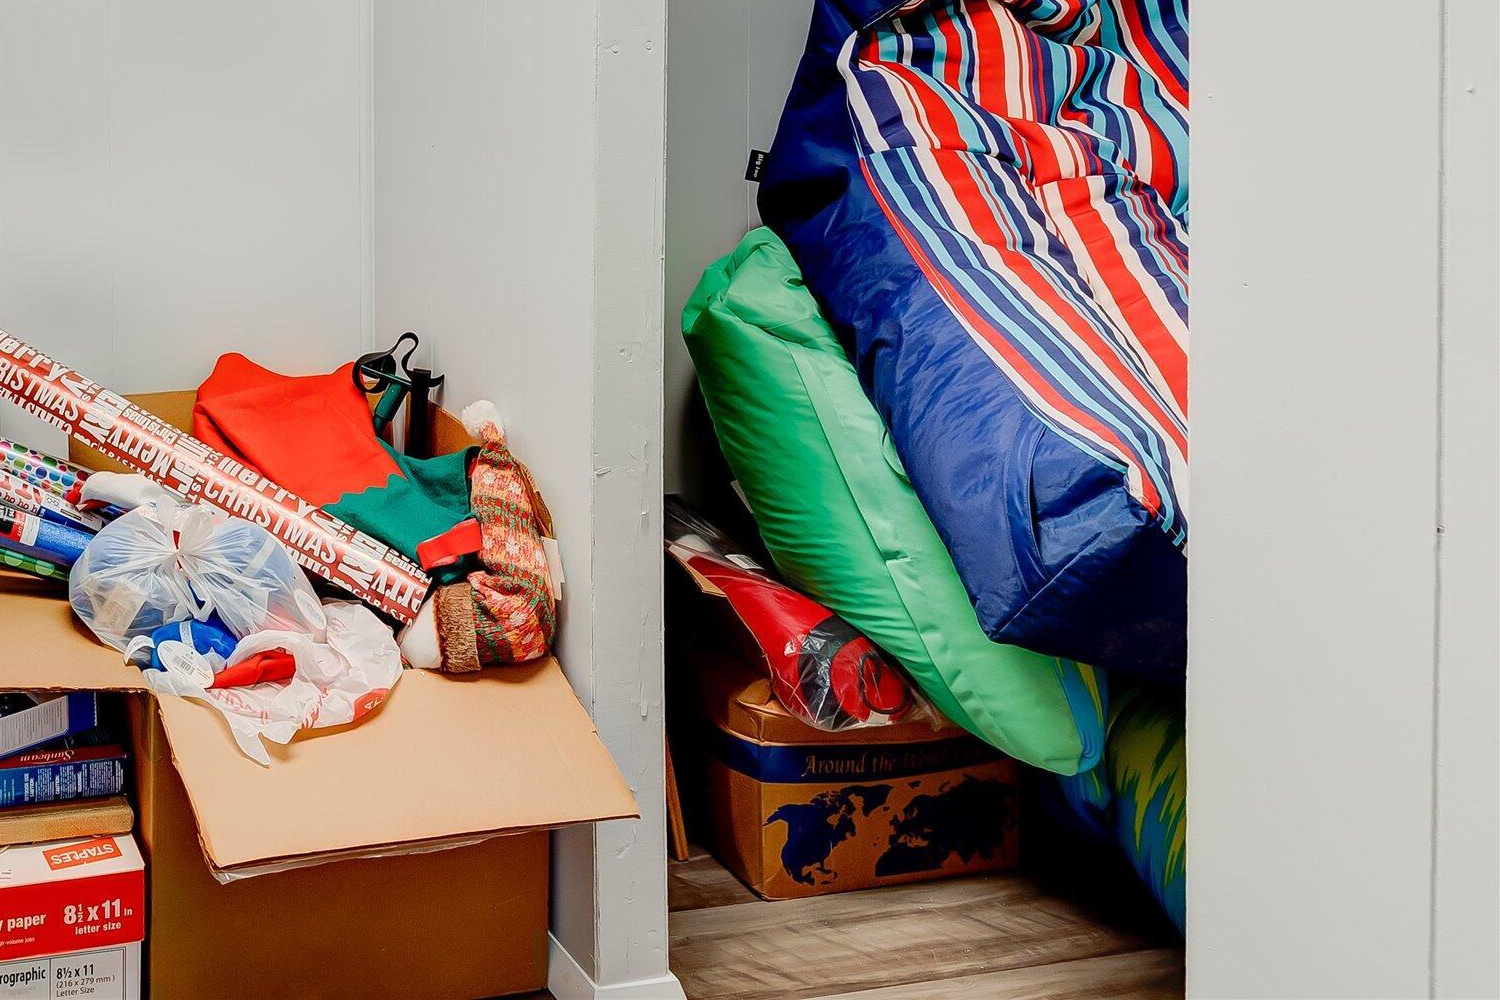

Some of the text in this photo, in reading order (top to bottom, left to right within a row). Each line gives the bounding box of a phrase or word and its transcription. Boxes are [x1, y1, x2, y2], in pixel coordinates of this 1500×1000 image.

[106, 424, 175, 479] Merry
[3, 492, 16, 506] ho
[16, 499, 30, 512] ho
[204, 477, 337, 564] CHRISTMAS
[20, 750, 75, 764] Sunbeam
[801, 752, 869, 777] Around
[871, 751, 896, 776] the
[50, 843, 115, 865] STAPLES
[87, 907, 99, 921] x
[101, 898, 121, 920] 11
[7, 913, 47, 933] paper
[75, 922, 122, 936] letter size
[83, 964, 94, 976] 11
[56, 979, 72, 989] (216
[80, 977, 95, 986] 279
[56, 986, 95, 998] Letter Size
